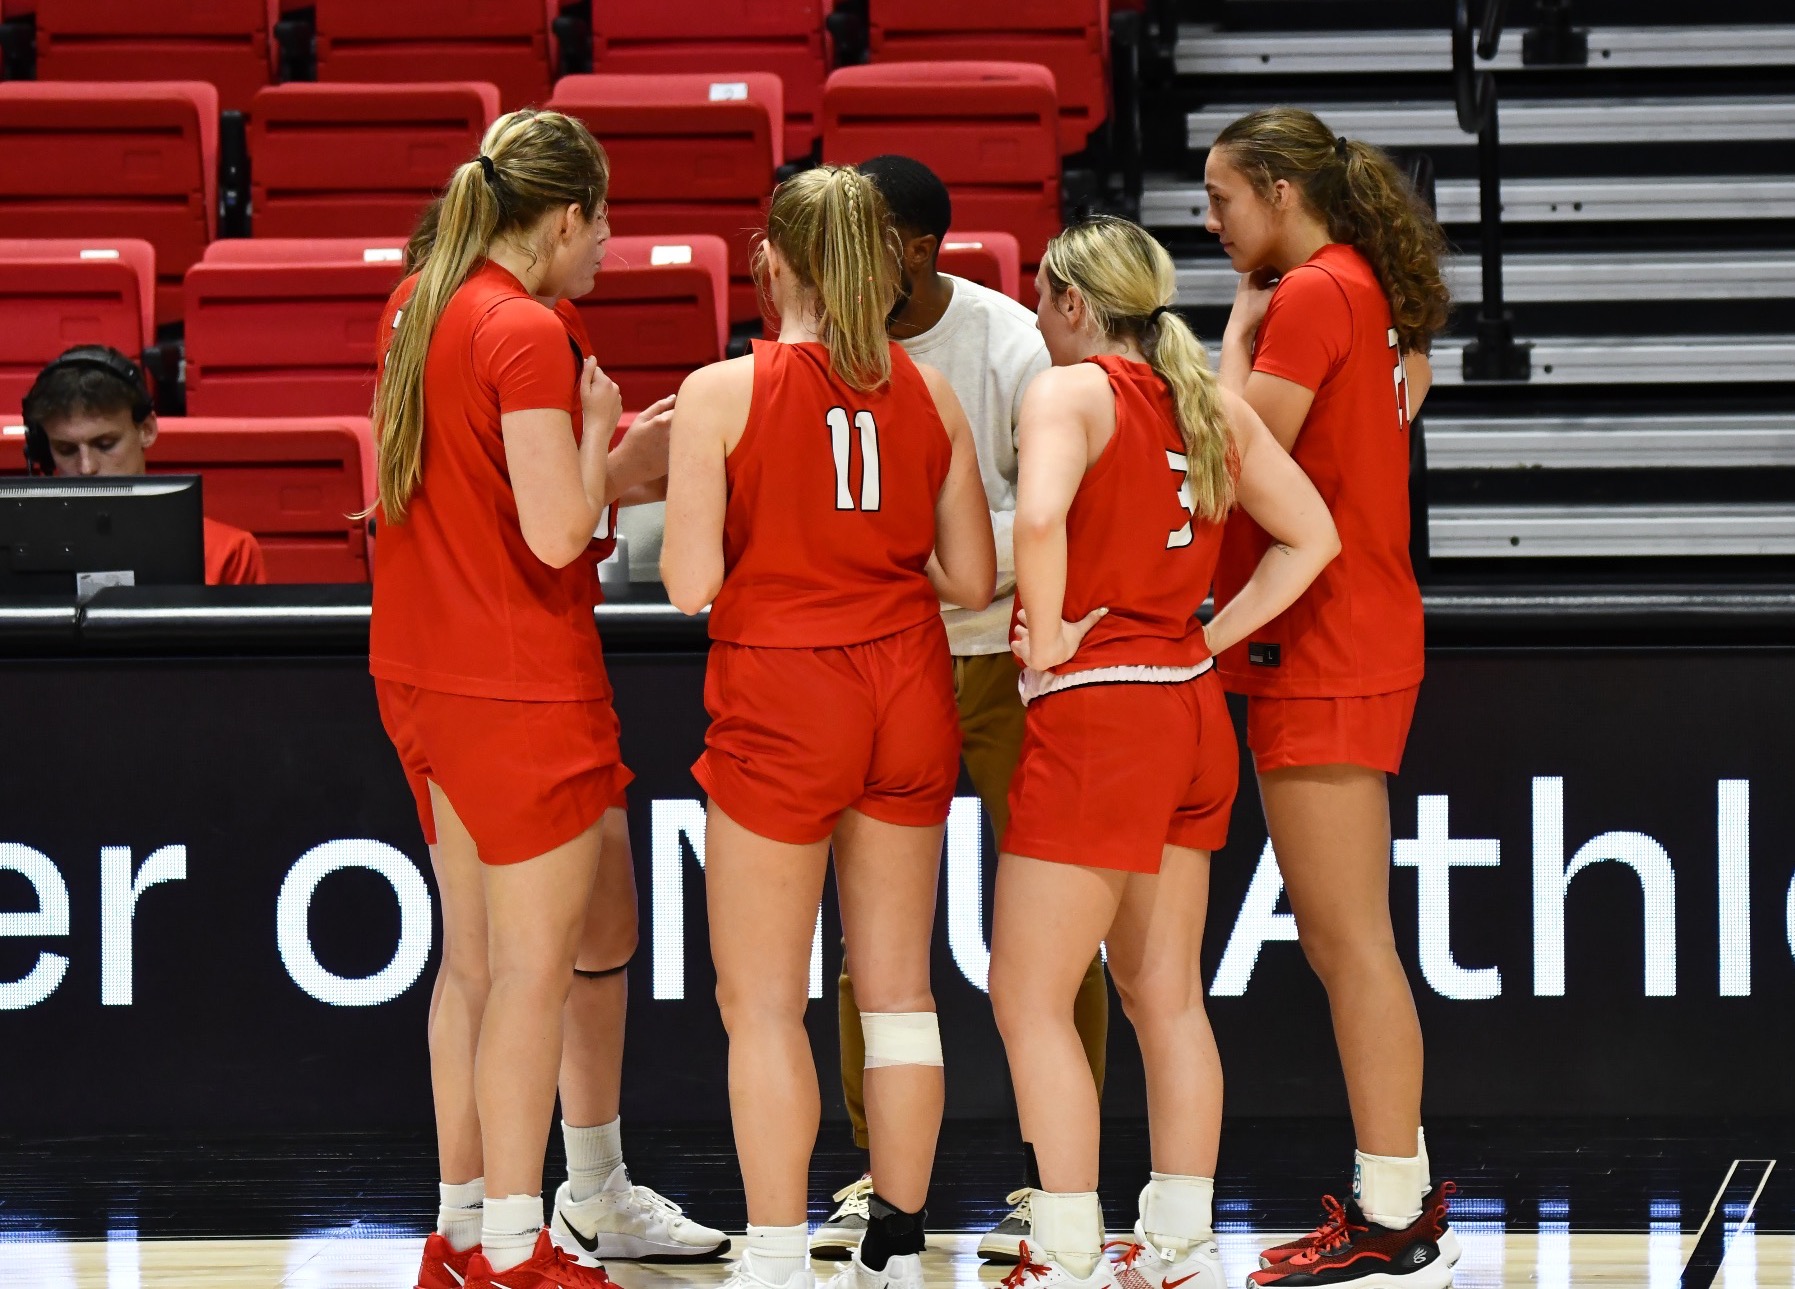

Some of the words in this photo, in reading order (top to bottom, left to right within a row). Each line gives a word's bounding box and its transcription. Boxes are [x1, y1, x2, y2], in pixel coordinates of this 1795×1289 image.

[826, 406, 881, 512] 11
[1165, 448, 1196, 550] 3
[276, 838, 432, 1006] o
